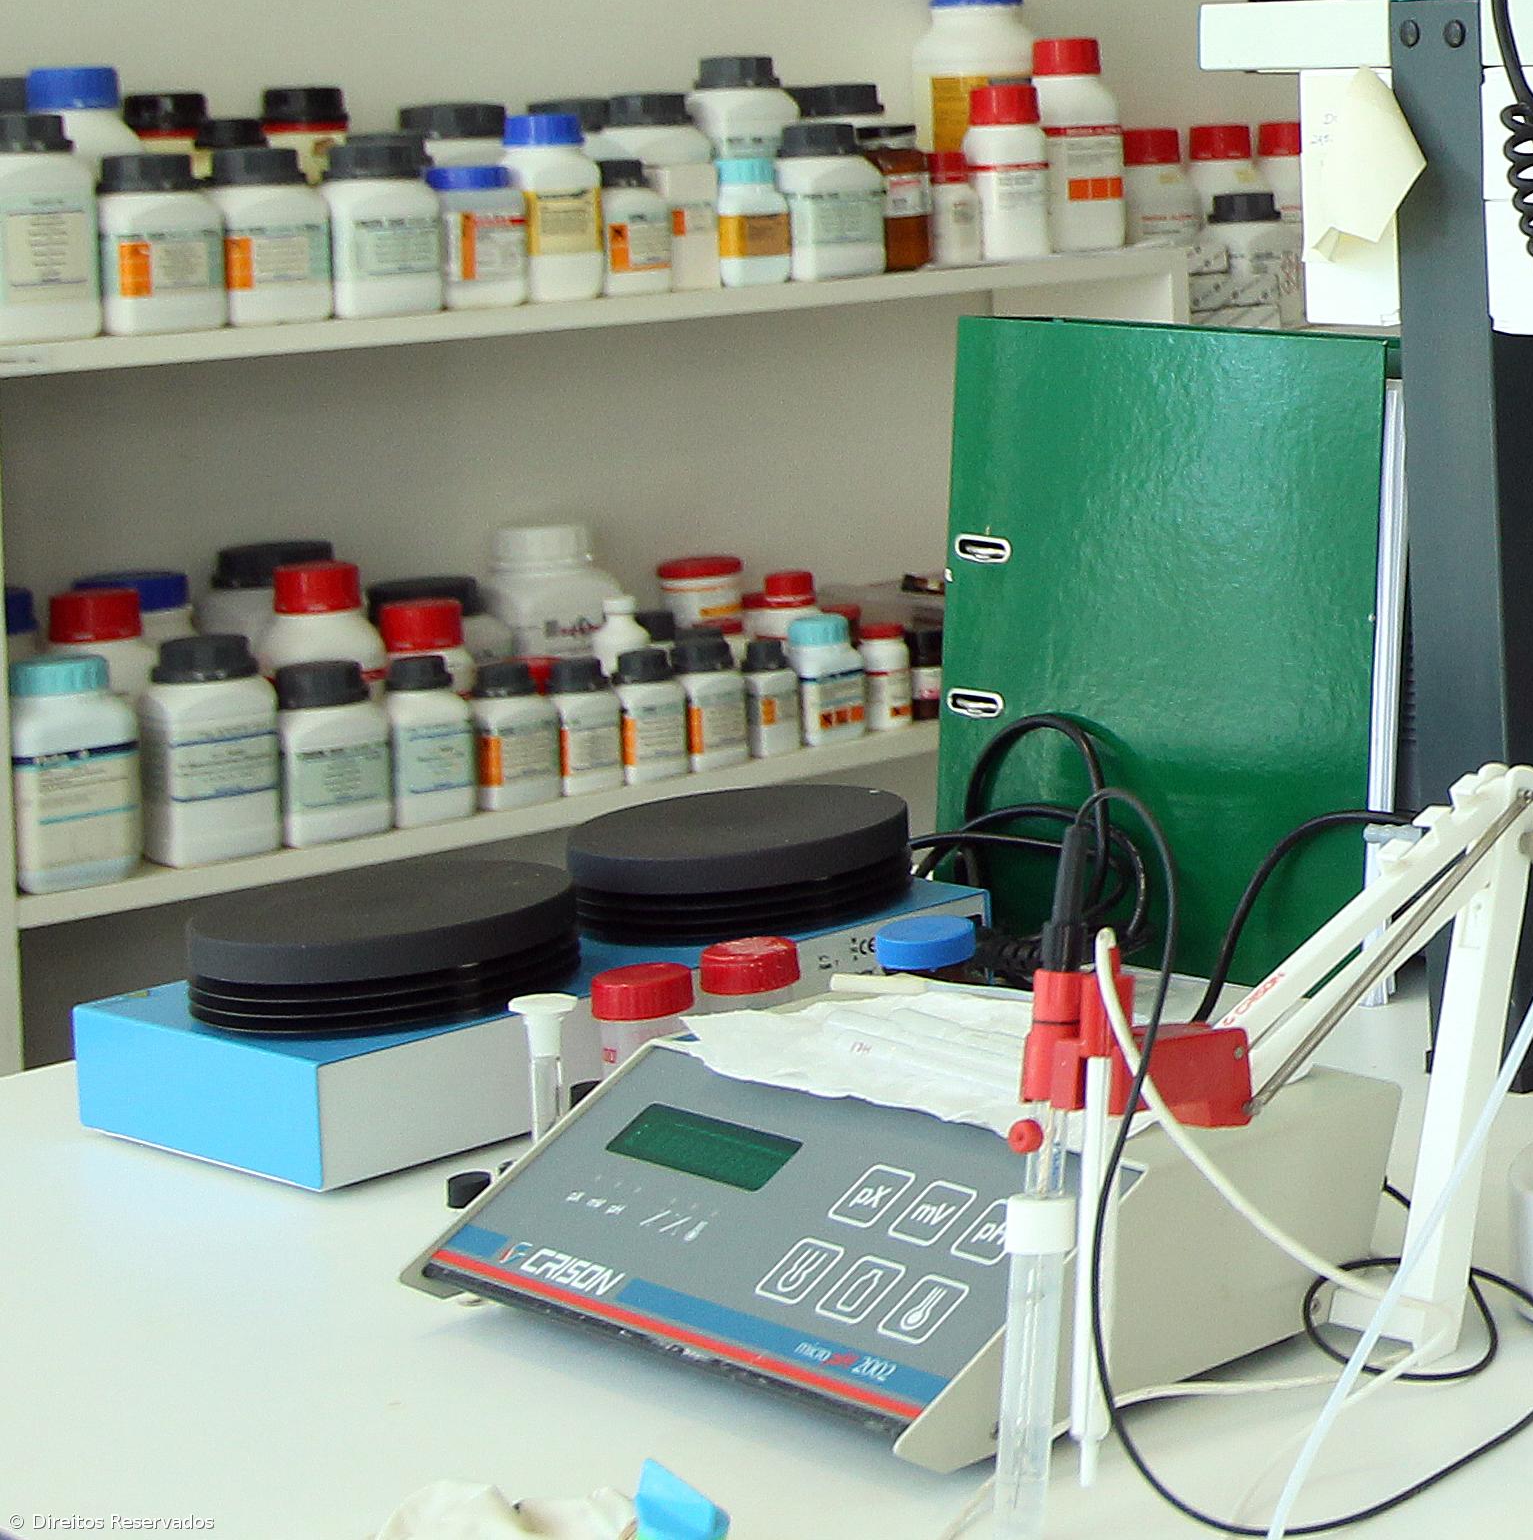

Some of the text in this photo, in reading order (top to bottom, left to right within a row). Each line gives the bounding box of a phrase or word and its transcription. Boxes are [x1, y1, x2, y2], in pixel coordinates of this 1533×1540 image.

[910, 1202, 957, 1226] mV
[519, 1247, 626, 1296] CRISON
[794, 1341, 832, 1362] micro
[851, 1355, 897, 1381] 2002
